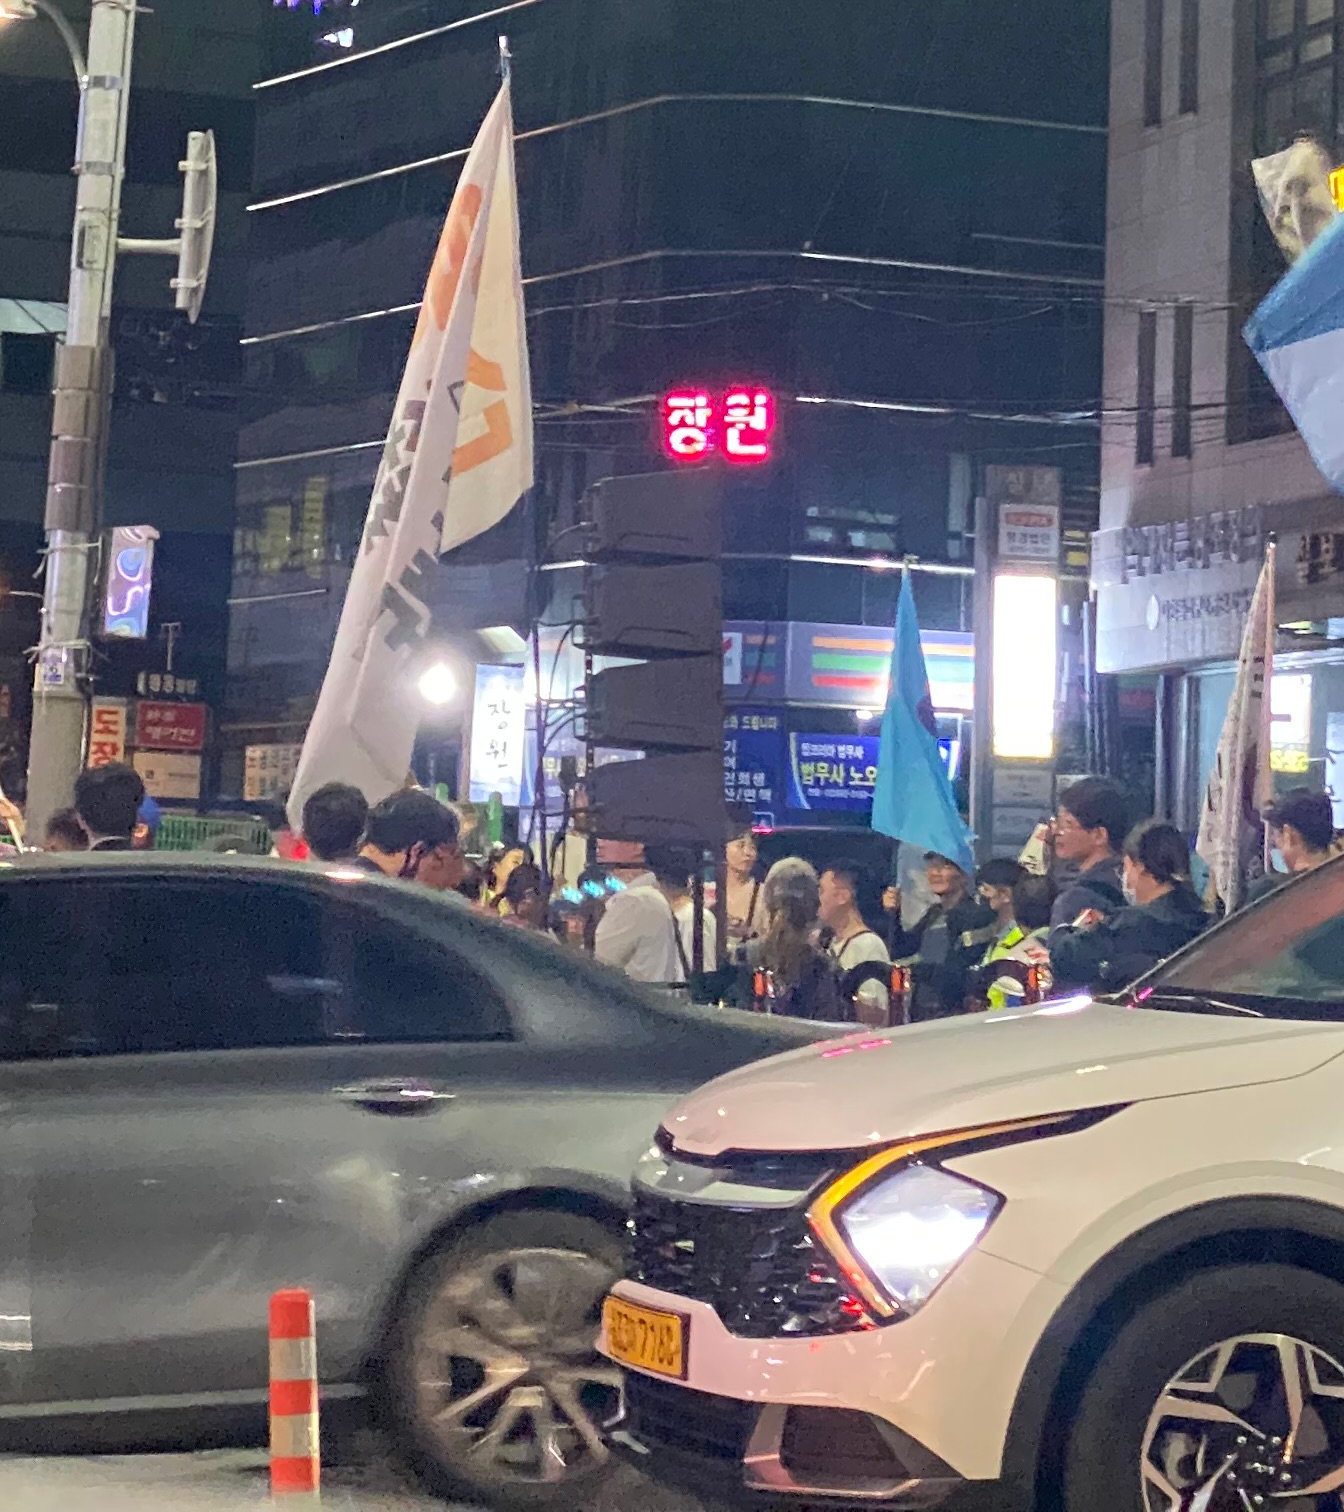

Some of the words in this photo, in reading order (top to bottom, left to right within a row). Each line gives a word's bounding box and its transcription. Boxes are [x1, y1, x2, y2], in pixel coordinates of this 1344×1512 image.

[666, 393, 768, 456] 장원
[485, 698, 512, 769] 장원
[800, 762, 845, 788] 법무사
